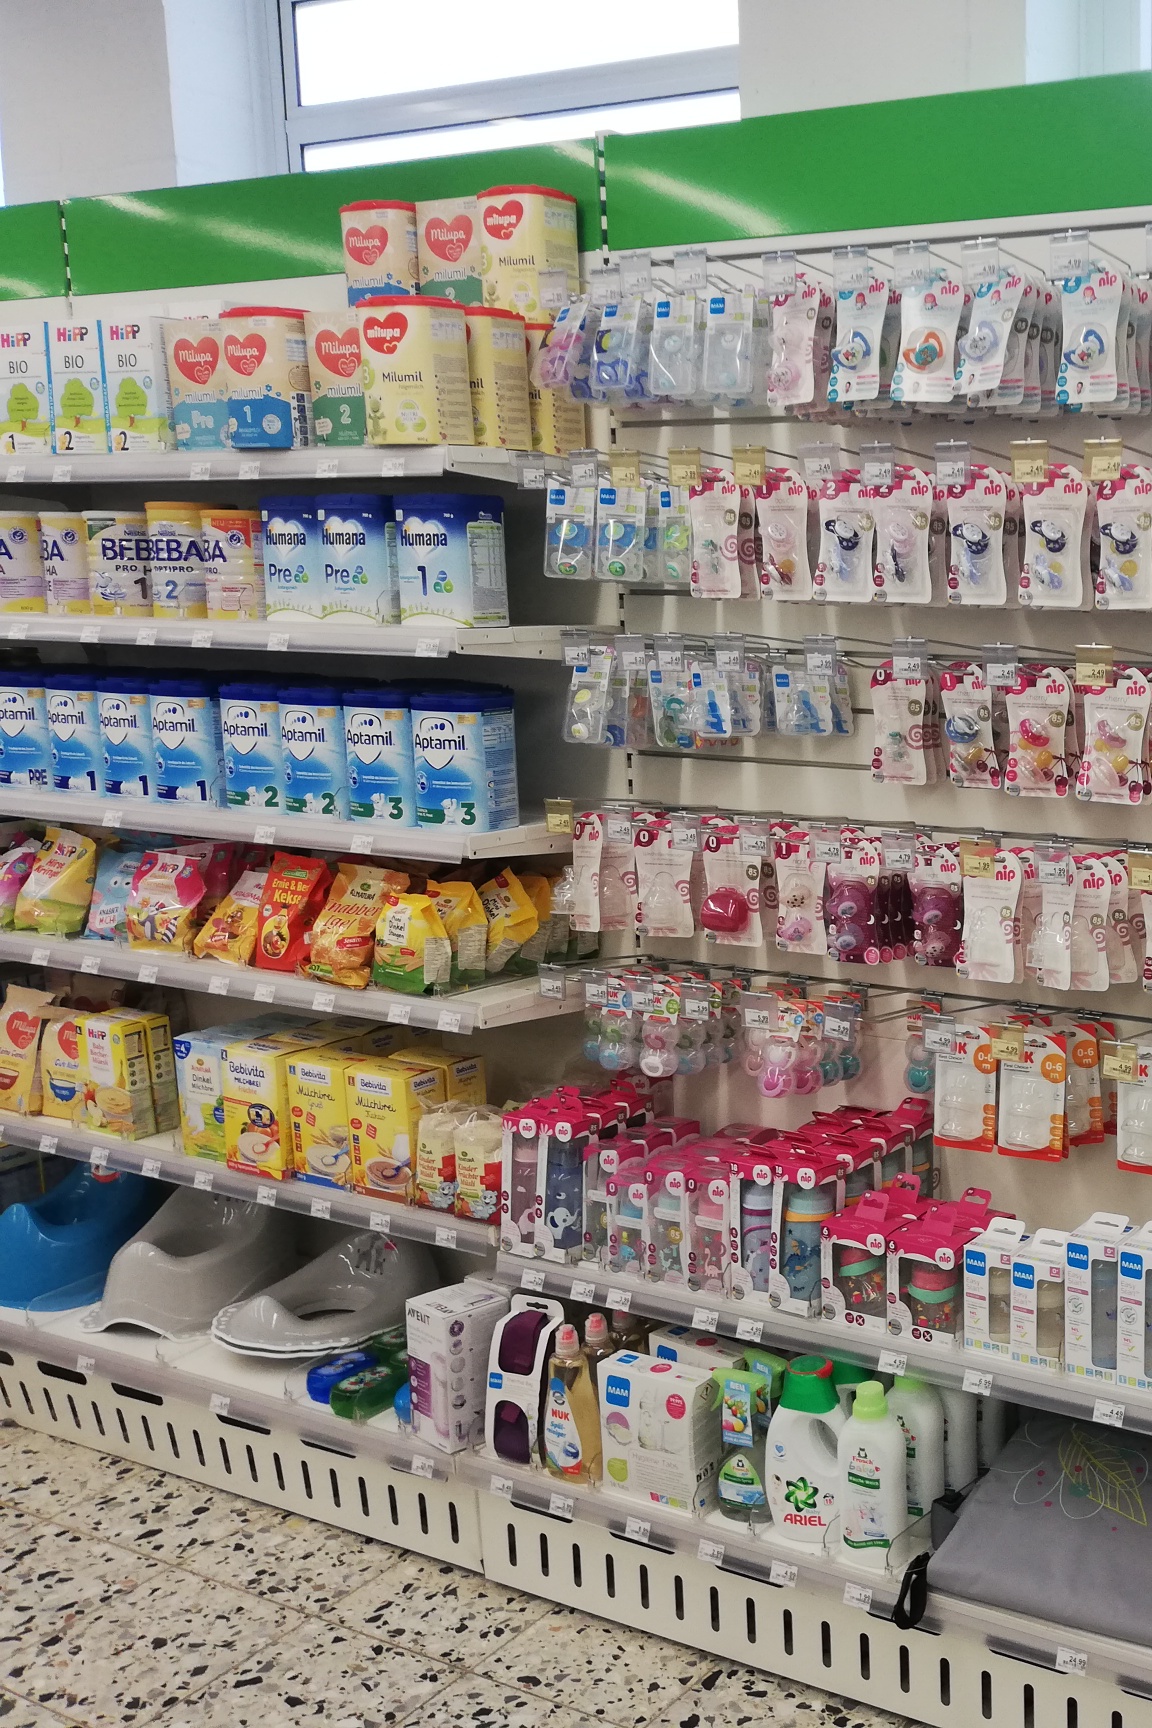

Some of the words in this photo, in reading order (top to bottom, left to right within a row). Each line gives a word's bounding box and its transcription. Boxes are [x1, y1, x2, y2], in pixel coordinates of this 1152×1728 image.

[487, 213, 516, 227] milupa
[349, 236, 380, 247] Milupa
[430, 228, 466, 240] Milupa
[499, 257, 536, 266] Milumil
[1005, 276, 1022, 290] nip
[1098, 271, 1117, 287] nip
[802, 284, 816, 299] nip
[940, 280, 960, 296] nip
[56, 327, 88, 342] HiPP
[109, 324, 140, 340] HiPP
[366, 326, 401, 340] milupa
[1, 332, 31, 348] HiPP
[227, 344, 259, 358] Milupa
[321, 342, 359, 354] Milupa
[63, 355, 84, 369] BIO
[118, 354, 137, 367] BIO
[179, 350, 213, 362] Milupa
[9, 361, 28, 374] BIO
[382, 372, 422, 383] Milumil
[191, 410, 214, 429] Pre
[244, 405, 252, 422] 1
[339, 405, 351, 424] 2
[722, 482, 736, 496] nip
[788, 482, 804, 496] nip
[910, 481, 929, 496] nip
[984, 480, 1001, 496] nip
[1064, 479, 1082, 494] nip
[1134, 479, 1152, 496] nip
[266, 529, 306, 546] Humana
[322, 529, 366, 546] Humana
[400, 530, 448, 547] Humana
[268, 564, 292, 583] Pre
[324, 564, 350, 584] Pre
[416, 566, 428, 596] 1
[165, 580, 178, 600] 2
[907, 662, 920, 670] 2.49
[1091, 668, 1105, 677] 2.49
[1046, 681, 1064, 694] nip
[1126, 682, 1146, 696] nip
[100, 713, 137, 729] Aptamil
[152, 717, 196, 734] Aptamil
[223, 721, 268, 738] Aptamil
[282, 726, 325, 743] Aptamil
[346, 730, 393, 747] Aptamil
[415, 734, 466, 751] Aptamil
[86, 770, 97, 791] 1
[139, 775, 149, 796] 1
[196, 780, 207, 801] 1
[264, 786, 280, 808] 2
[388, 797, 404, 820] 3
[460, 802, 476, 826] 3
[859, 852, 876, 866] nip
[940, 860, 956, 874] nip
[995, 865, 1016, 881] nip
[1083, 873, 1105, 889] nip
[88, 1028, 107, 1041] HiPP
[1077, 1047, 1094, 1058] 0-6
[229, 1061, 265, 1079] Bebivita
[1045, 1061, 1064, 1072] 0-6
[300, 1068, 326, 1081] Bebivita
[360, 1078, 387, 1091] Bebivita
[296, 1086, 336, 1101] Milchbrei
[355, 1096, 397, 1113] Milchbrei
[966, 1257, 985, 1268] MAM
[1068, 1250, 1088, 1262] MAM
[1122, 1260, 1143, 1272] MAM
[1014, 1270, 1034, 1282] MAM
[607, 1385, 629, 1397] MAM
[551, 1408, 570, 1421] NUK
[783, 1512, 827, 1528] ARIEL
